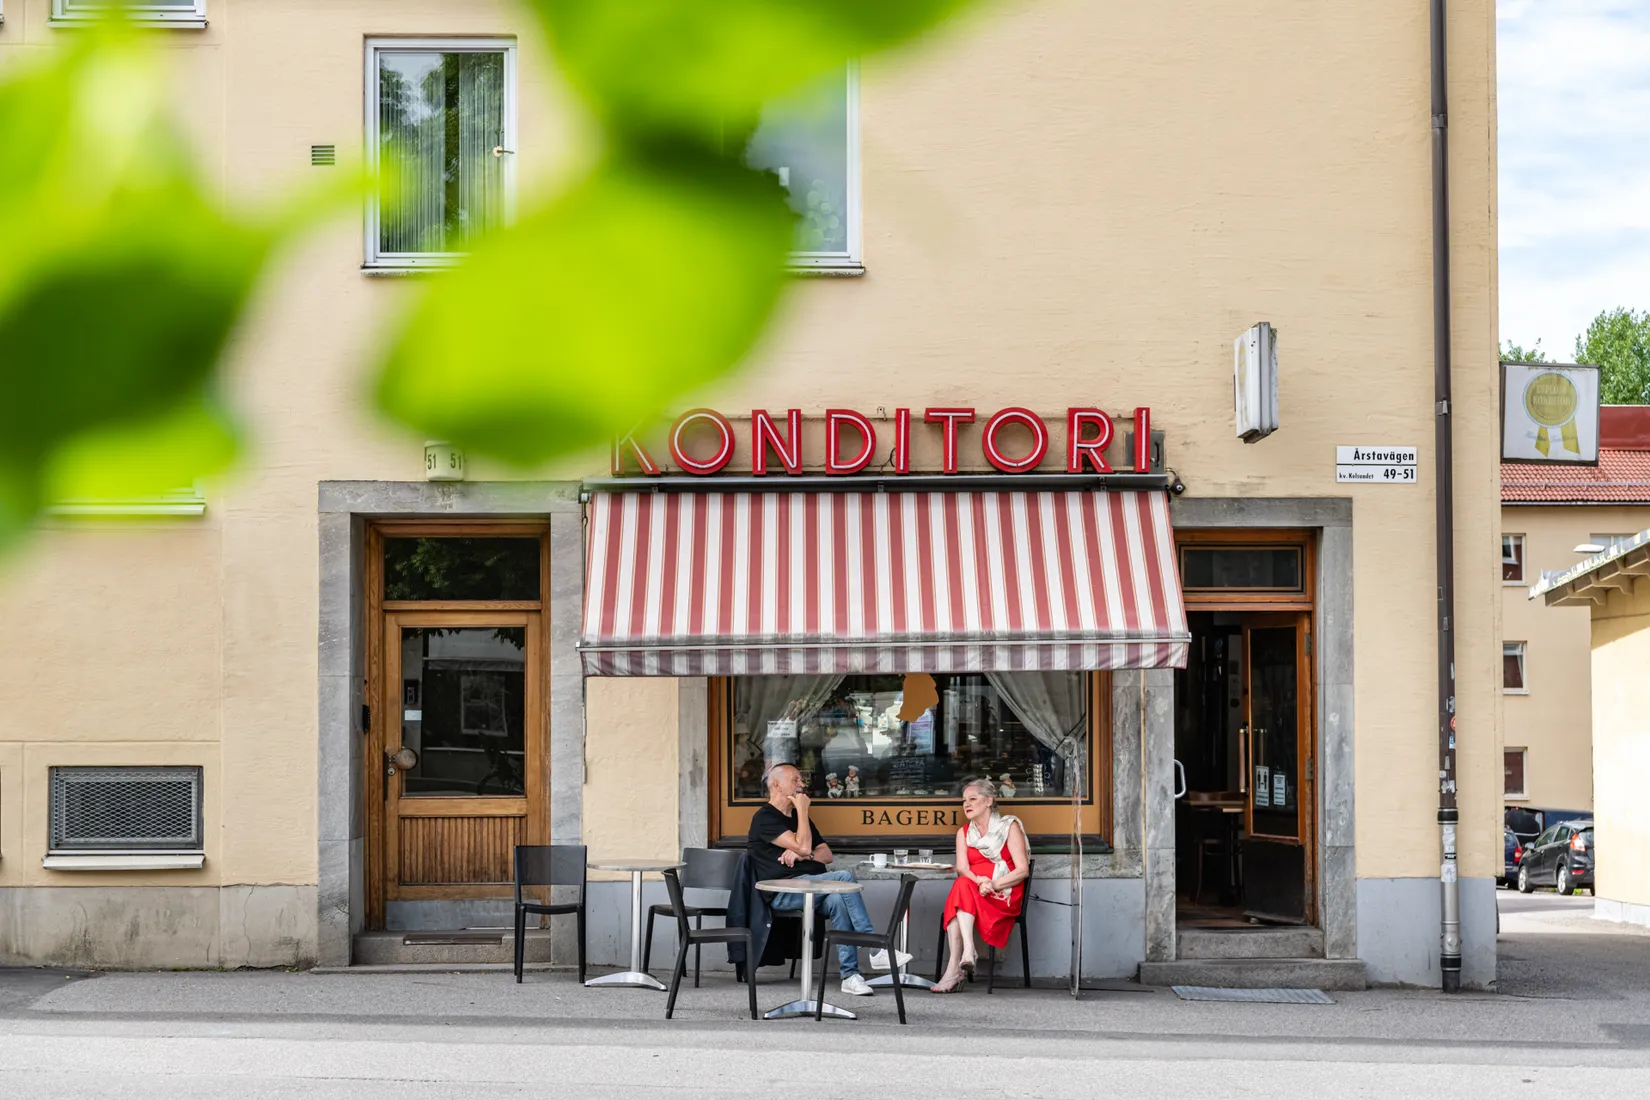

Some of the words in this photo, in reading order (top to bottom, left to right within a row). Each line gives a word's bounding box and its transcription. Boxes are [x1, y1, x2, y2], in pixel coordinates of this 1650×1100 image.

[611, 407, 1151, 475] KONDITORI
[427, 453, 437, 470] 51
[450, 453, 462, 470] 51
[1353, 448, 1415, 463] Årstavägen
[1339, 472, 1349, 480] kv.
[1383, 468, 1415, 480] 49-51
[861, 809, 959, 826] BAGERI
